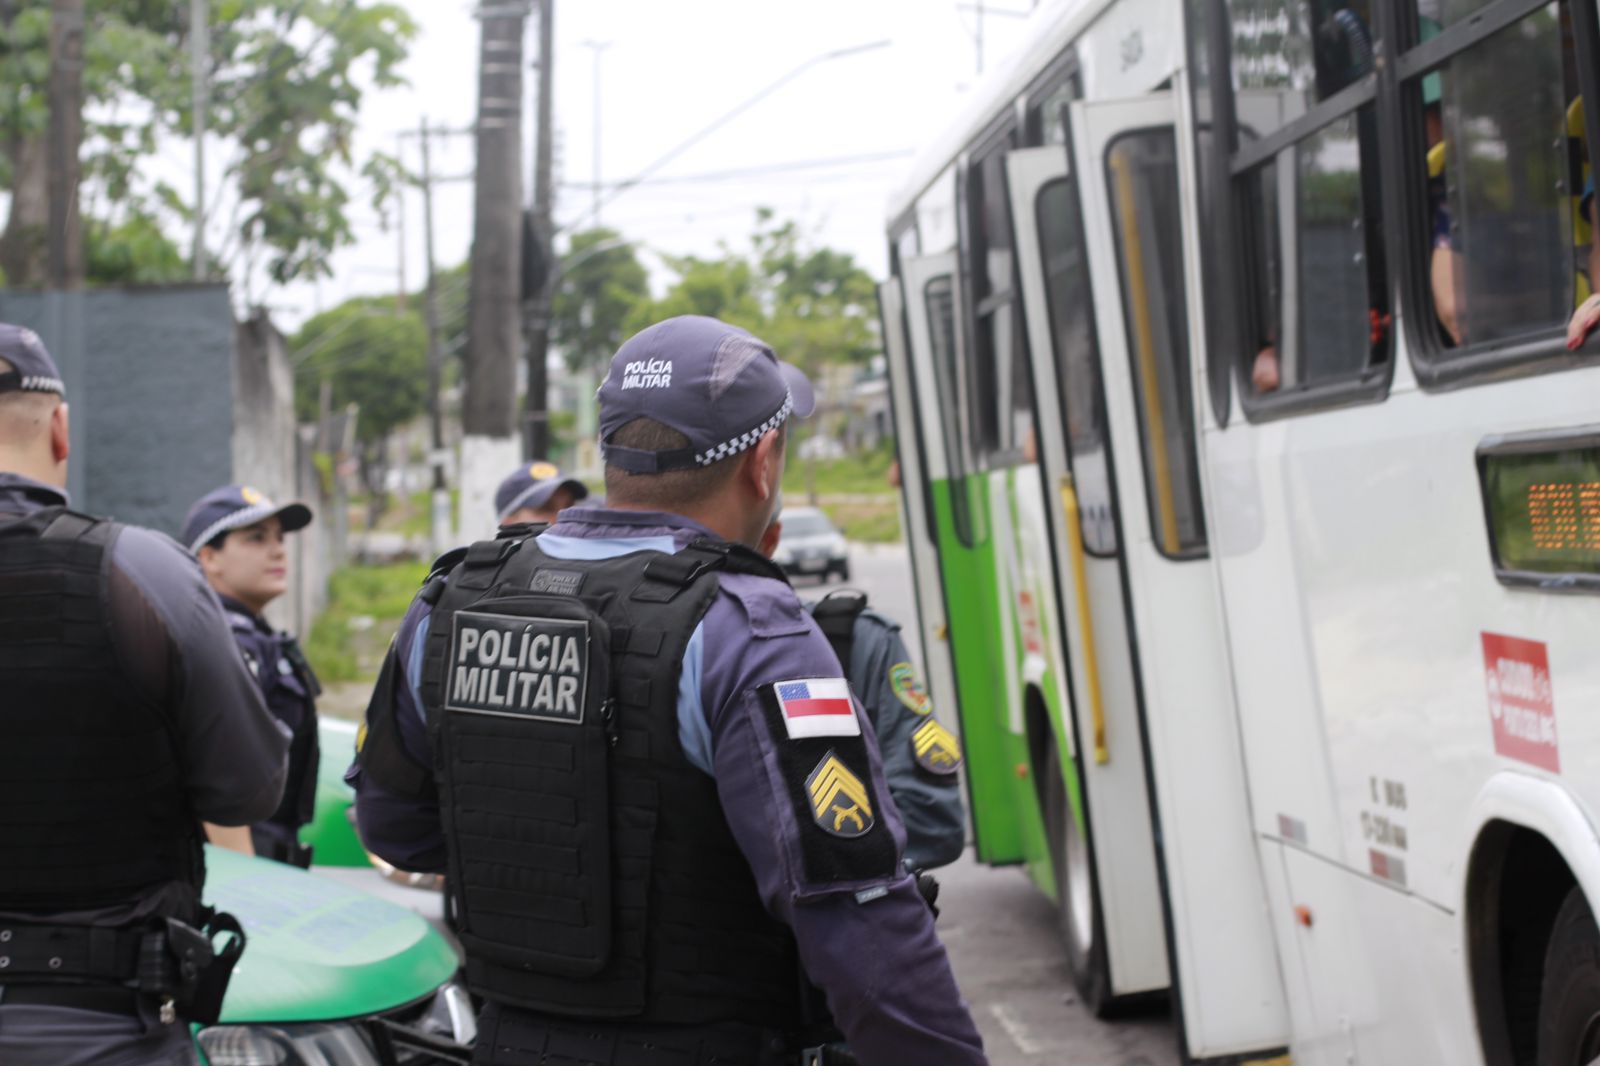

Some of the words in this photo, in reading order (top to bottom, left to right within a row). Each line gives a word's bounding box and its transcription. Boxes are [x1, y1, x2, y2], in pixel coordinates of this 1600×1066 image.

[621, 374, 672, 391] MILITAR
[624, 357, 673, 376] POLÍCIA
[457, 624, 581, 674] POLÍCIA
[452, 665, 579, 714] MILITAR
